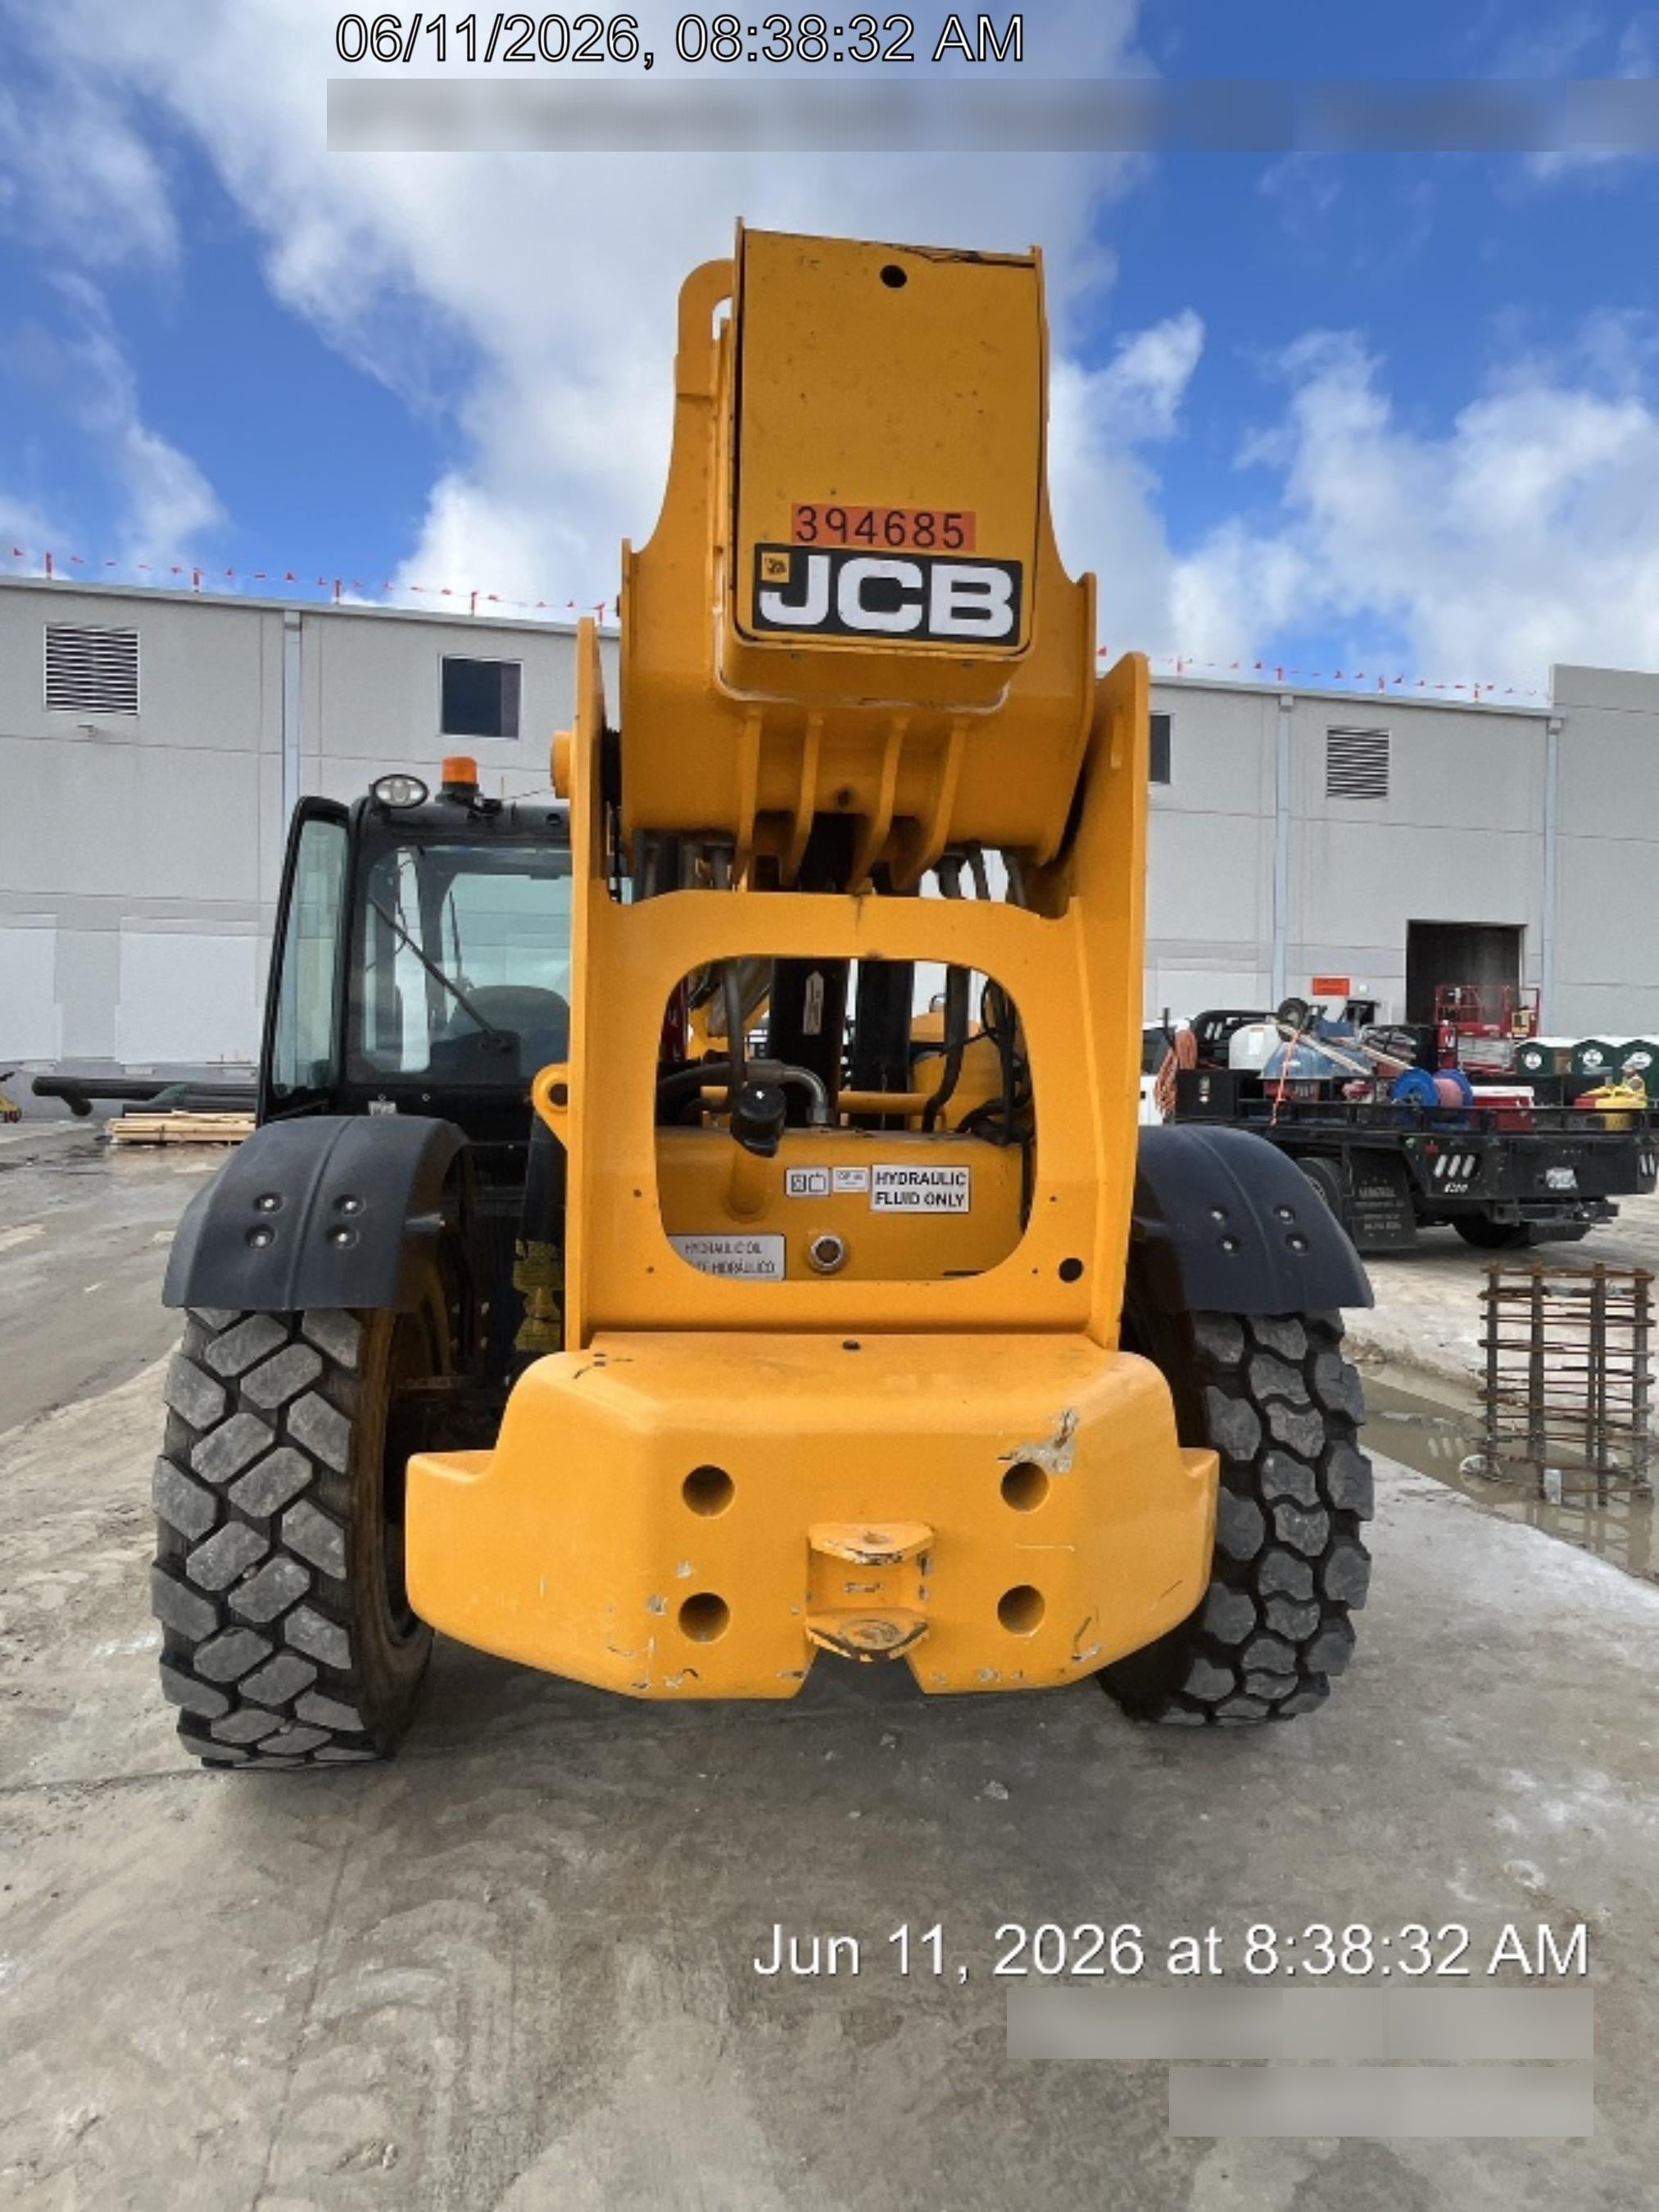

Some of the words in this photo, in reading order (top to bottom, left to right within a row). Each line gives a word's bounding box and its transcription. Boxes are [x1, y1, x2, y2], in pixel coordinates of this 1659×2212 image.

[796, 505, 964, 549] 394685
[759, 555, 1015, 638] JCB
[875, 1170, 967, 1187] HYDRAULIC
[874, 1190, 920, 1206] FLUID
[923, 1192, 965, 1208] ONLY
